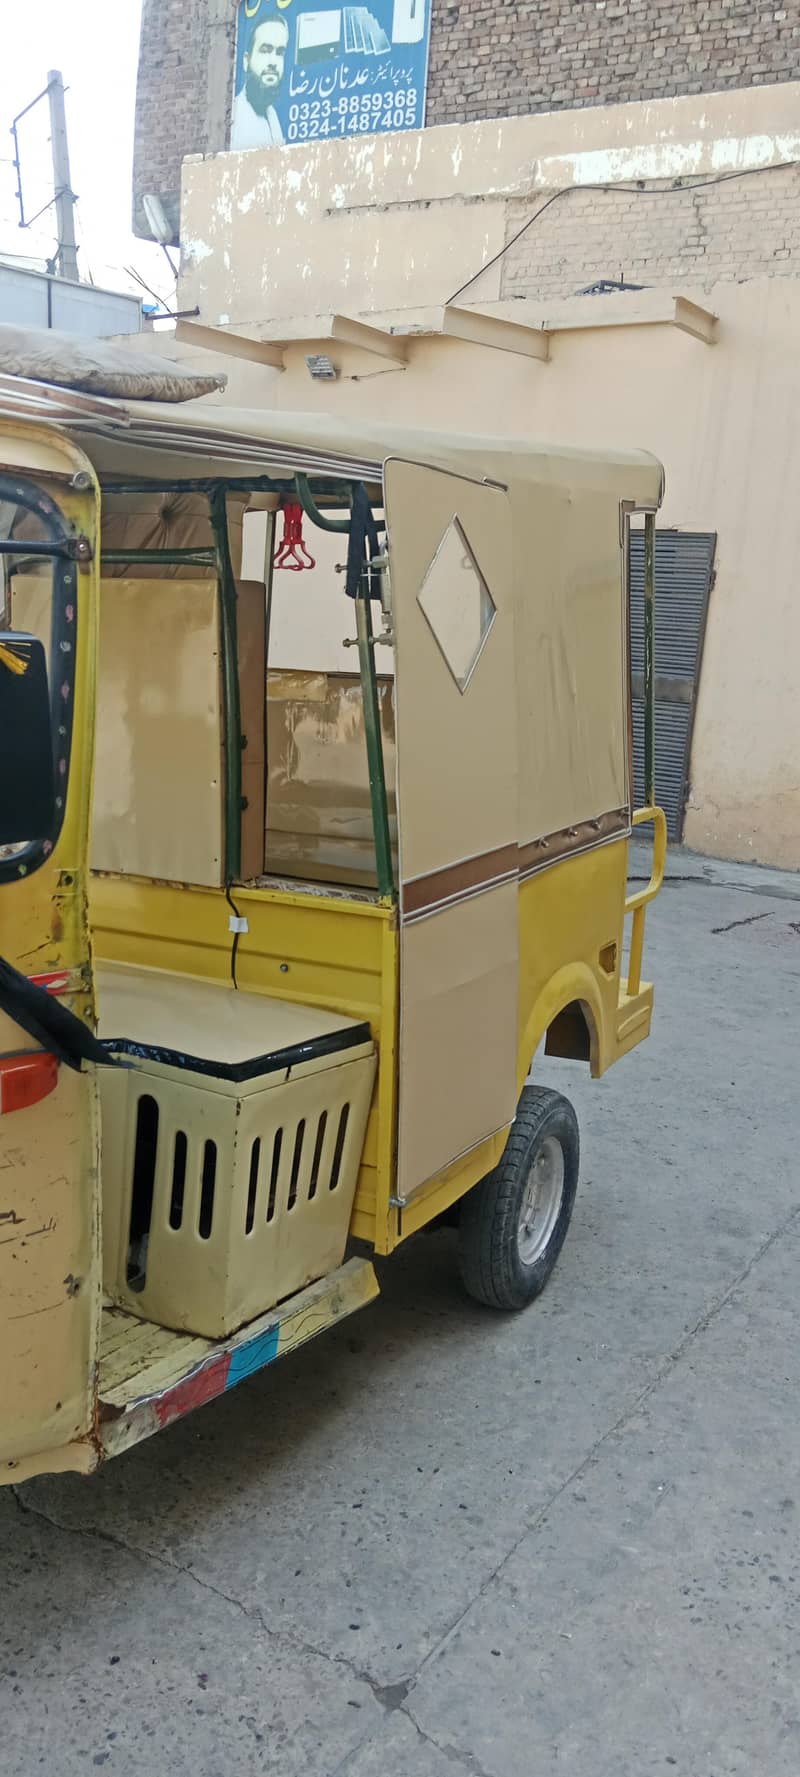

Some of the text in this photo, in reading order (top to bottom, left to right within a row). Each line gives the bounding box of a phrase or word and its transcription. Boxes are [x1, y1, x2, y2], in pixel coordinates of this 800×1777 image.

[289, 70, 318, 97] رضا
[319, 63, 369, 97] عدنان
[289, 88, 417, 121] 0323-8859368
[288, 107, 416, 140] 0324-1487405
